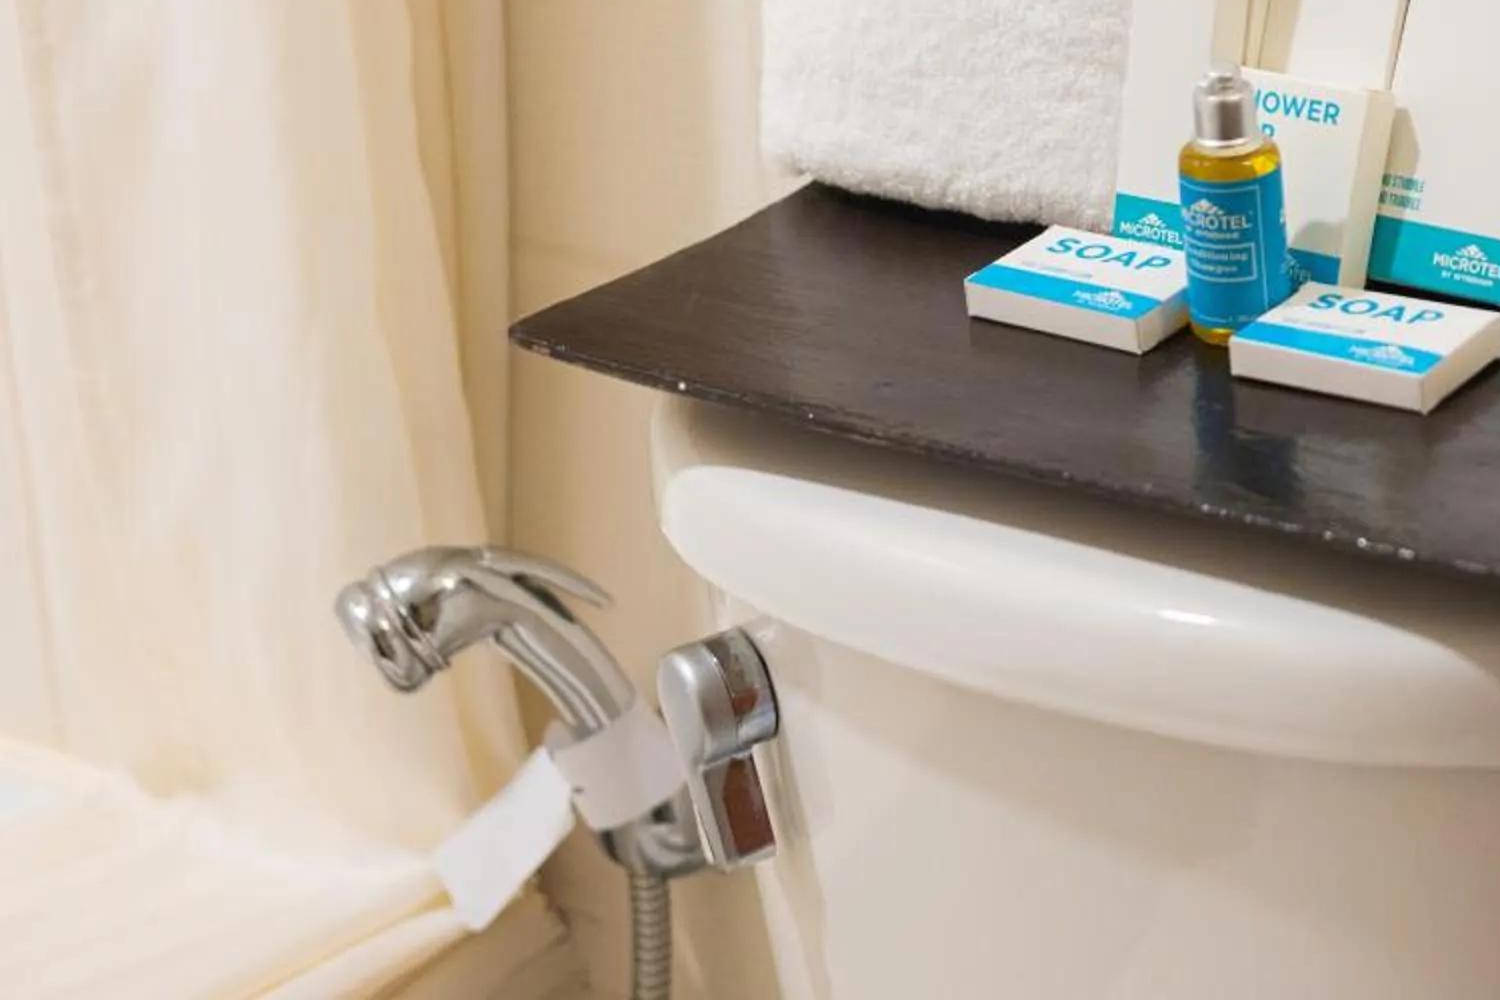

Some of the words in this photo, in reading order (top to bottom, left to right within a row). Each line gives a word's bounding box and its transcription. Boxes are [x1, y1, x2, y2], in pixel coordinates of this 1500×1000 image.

[1254, 88, 1341, 126] OWER
[1119, 221, 1183, 245] MICROTEL
[1045, 237, 1172, 270] SOAP
[1307, 292, 1445, 325] SOAP
